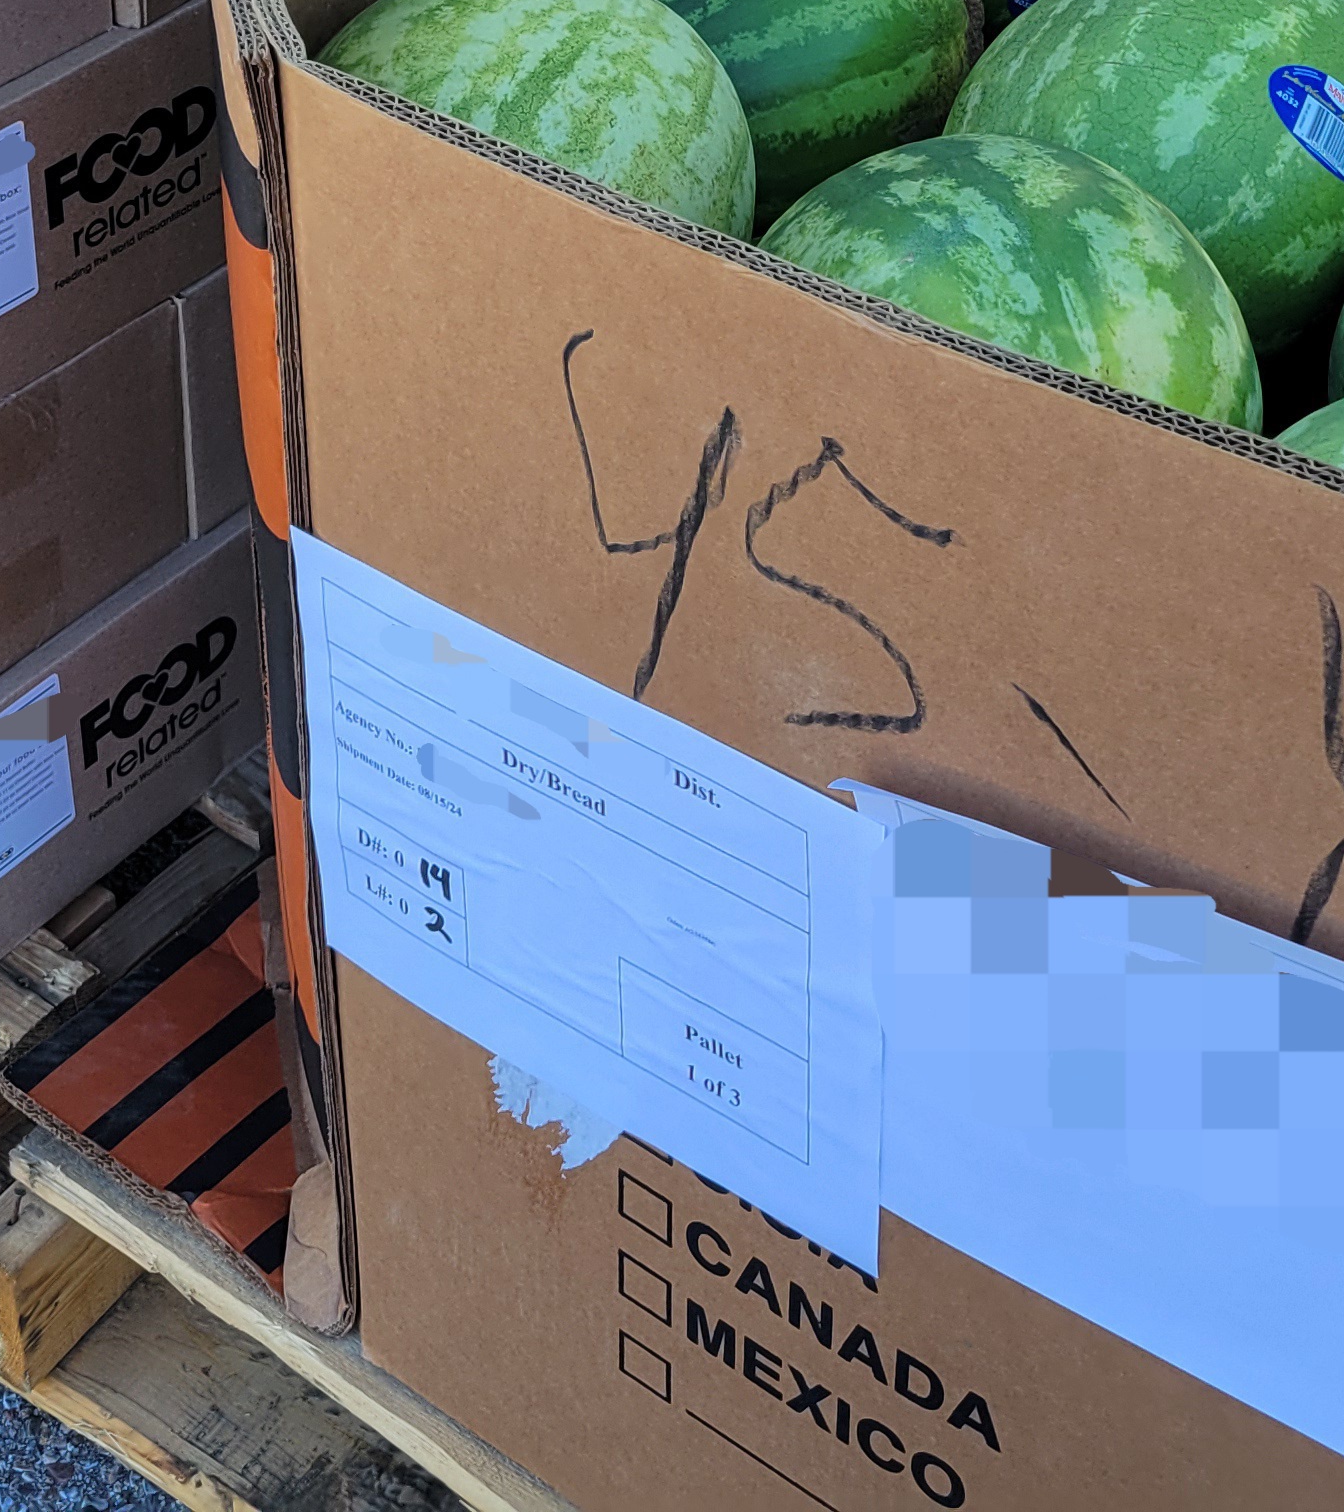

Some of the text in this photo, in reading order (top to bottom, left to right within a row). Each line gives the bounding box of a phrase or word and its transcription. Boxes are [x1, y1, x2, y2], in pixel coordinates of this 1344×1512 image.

[1276, 90, 1299, 108] 4032
[44, 86, 217, 230] FOOD
[72, 156, 202, 258] related
[80, 616, 237, 770] FOOD
[336, 700, 381, 738] Agency
[106, 680, 221, 789] related
[337, 737, 463, 818] Shipment Date: 08/15/24
[502, 747, 606, 817] Dry/Bread
[673, 768, 721, 809] Dist.
[358, 827, 452, 902] D#: 0 14
[365, 874, 393, 907] L#:
[424, 905, 453, 944] 2
[685, 1024, 743, 1069] Pallet
[688, 1065, 741, 1107] 1 of 3
[686, 1221, 1002, 1453] CANADA
[686, 1297, 966, 1509] MEXICO
